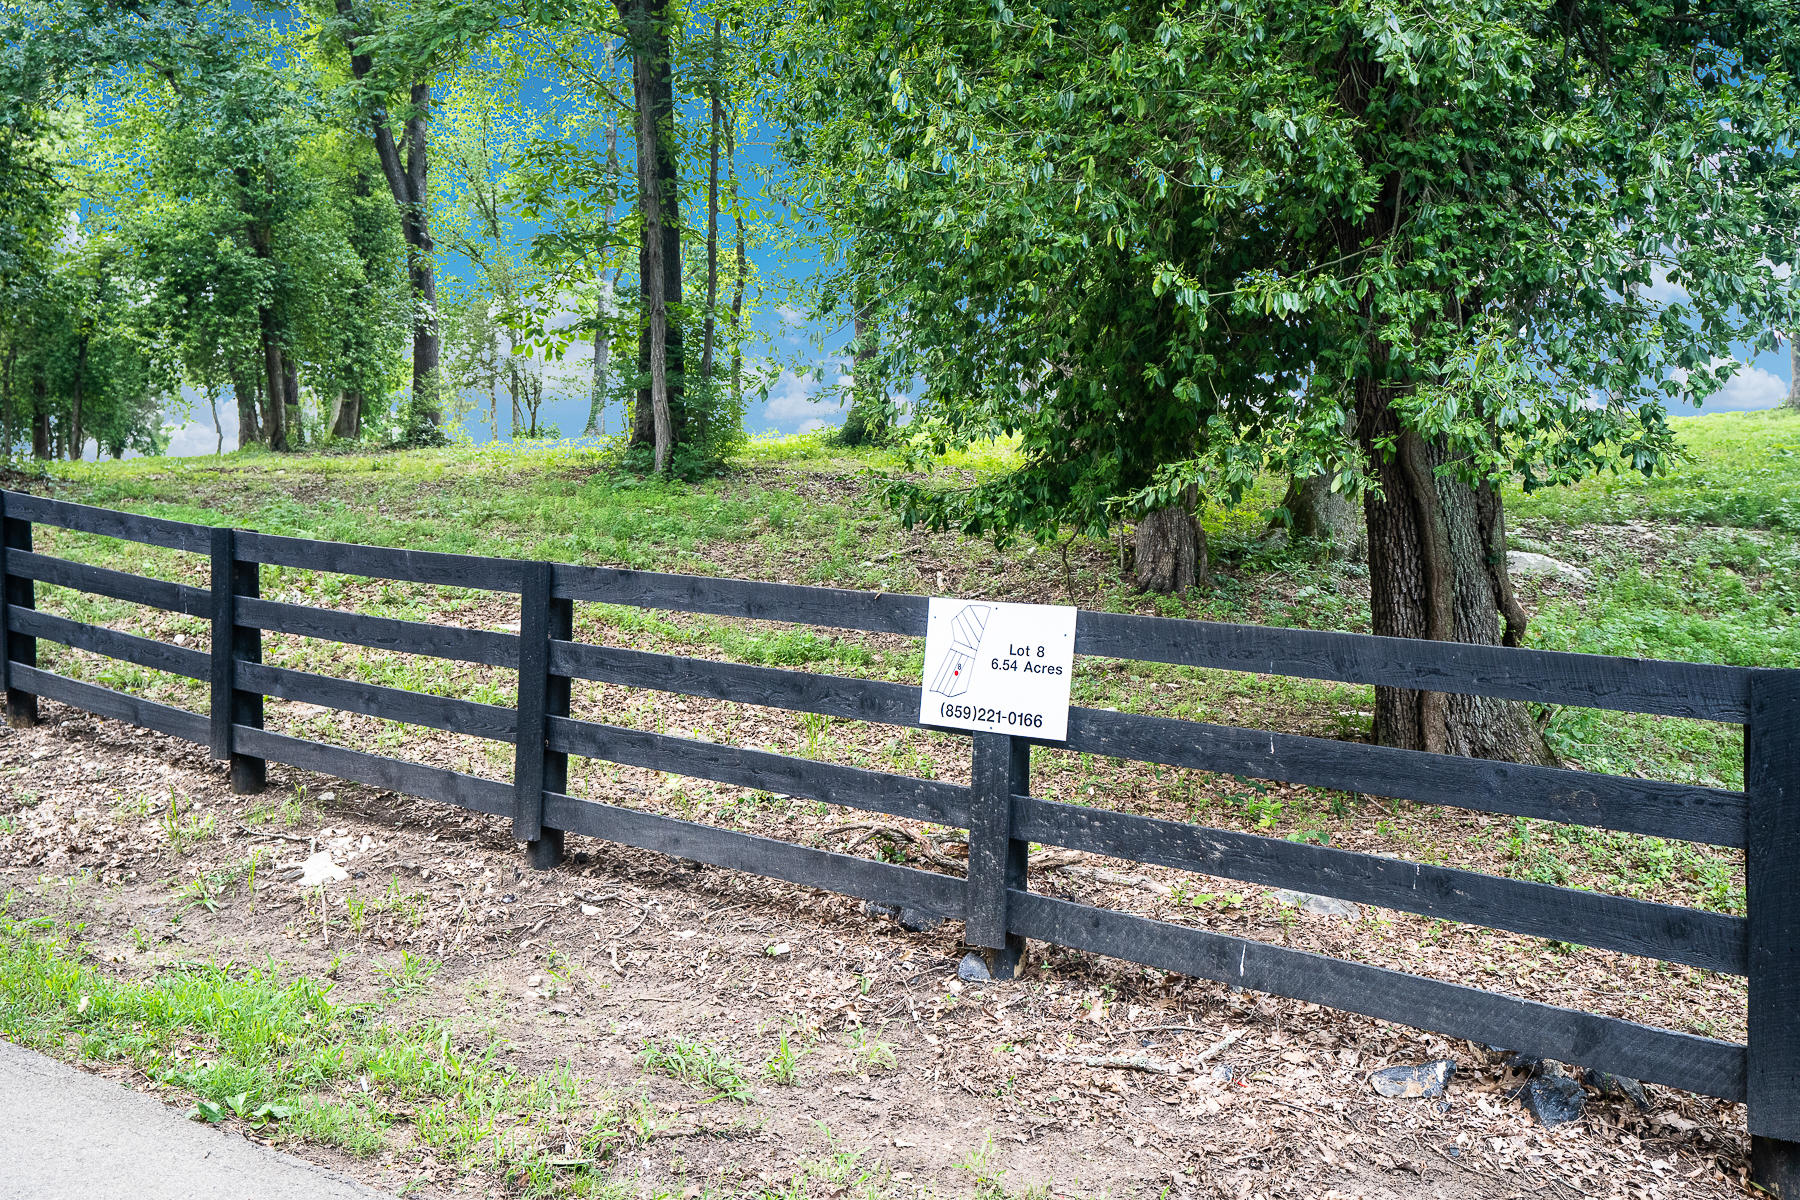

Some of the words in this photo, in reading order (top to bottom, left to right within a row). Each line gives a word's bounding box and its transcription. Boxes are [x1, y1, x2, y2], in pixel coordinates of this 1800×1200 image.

[1009, 643, 1031, 657] Lot
[1036, 645, 1045, 658] 8
[991, 657, 1018, 672] 6.54
[1023, 660, 1063, 676] Acres
[940, 702, 1043, 728] (859)221-0166
